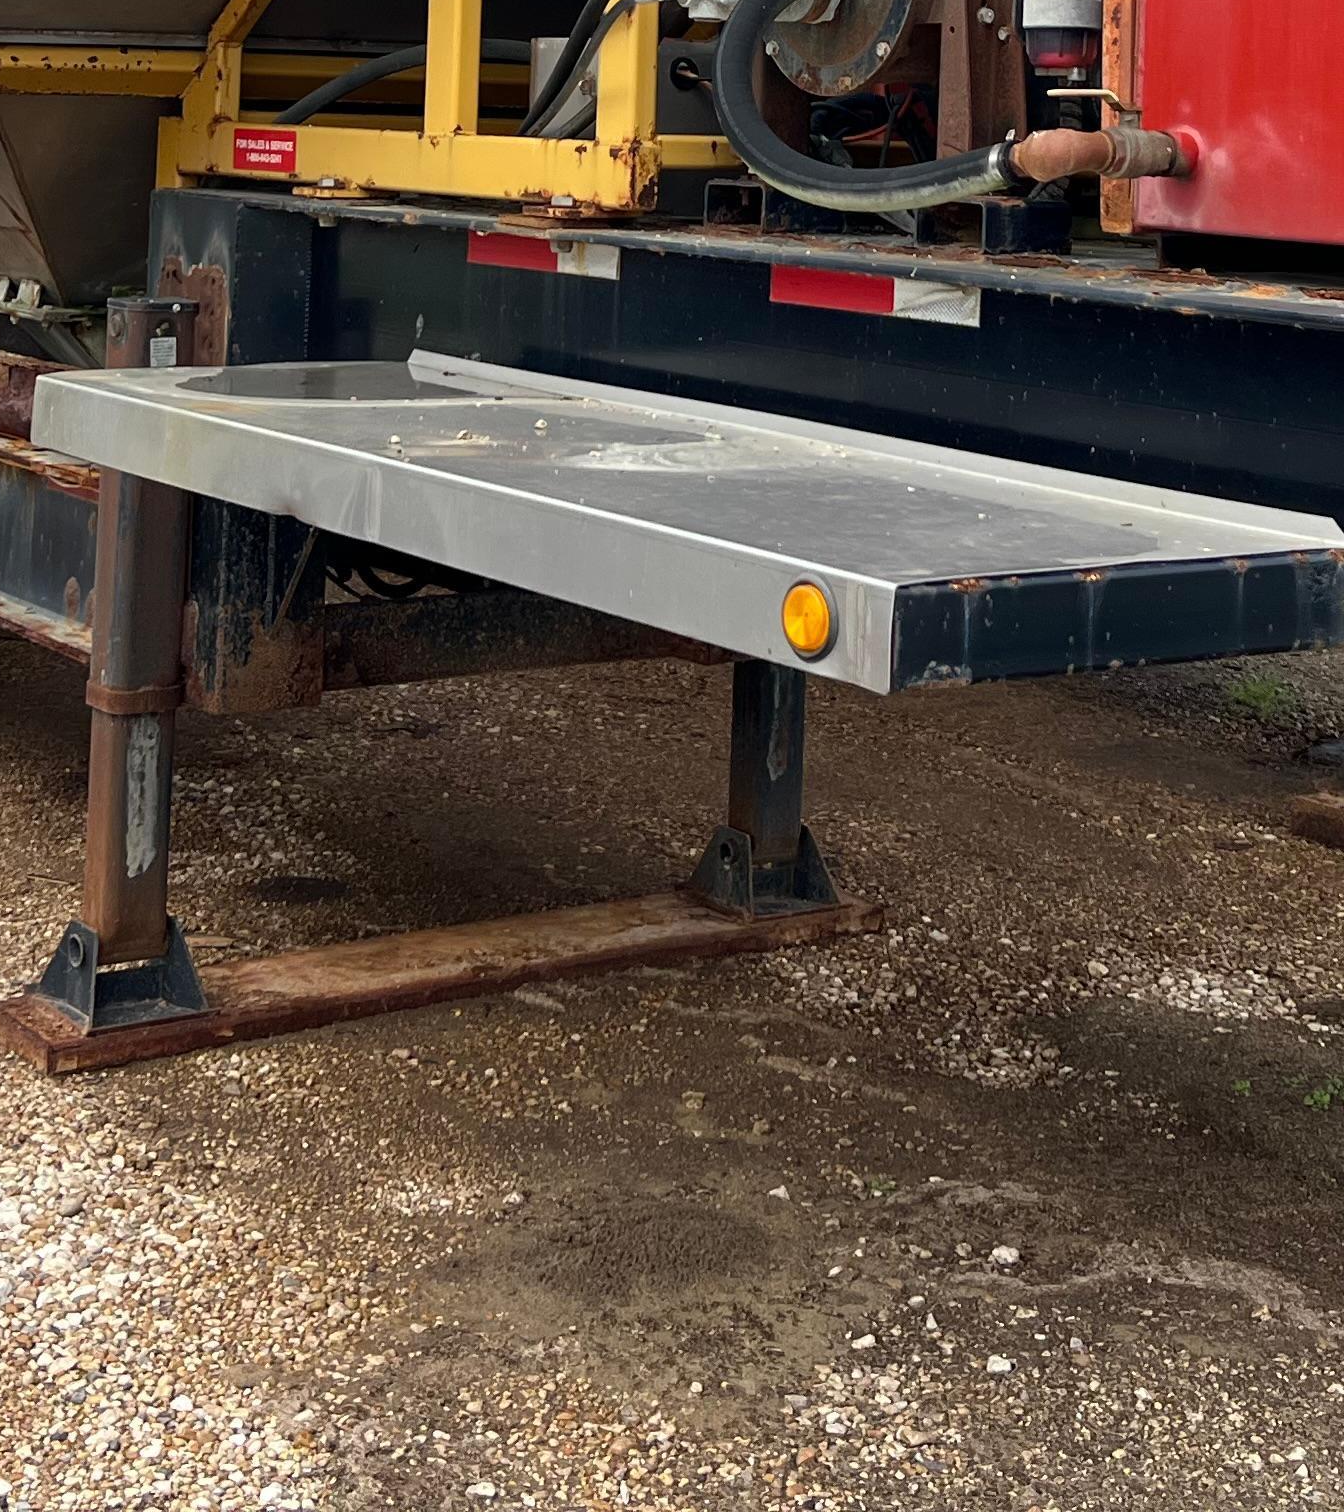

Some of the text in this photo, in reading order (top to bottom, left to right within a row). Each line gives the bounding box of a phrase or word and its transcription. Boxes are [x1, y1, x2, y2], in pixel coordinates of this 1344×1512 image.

[236, 138, 247, 148] FOR
[247, 139, 265, 150] SALES
[270, 140, 294, 152] SERVICE
